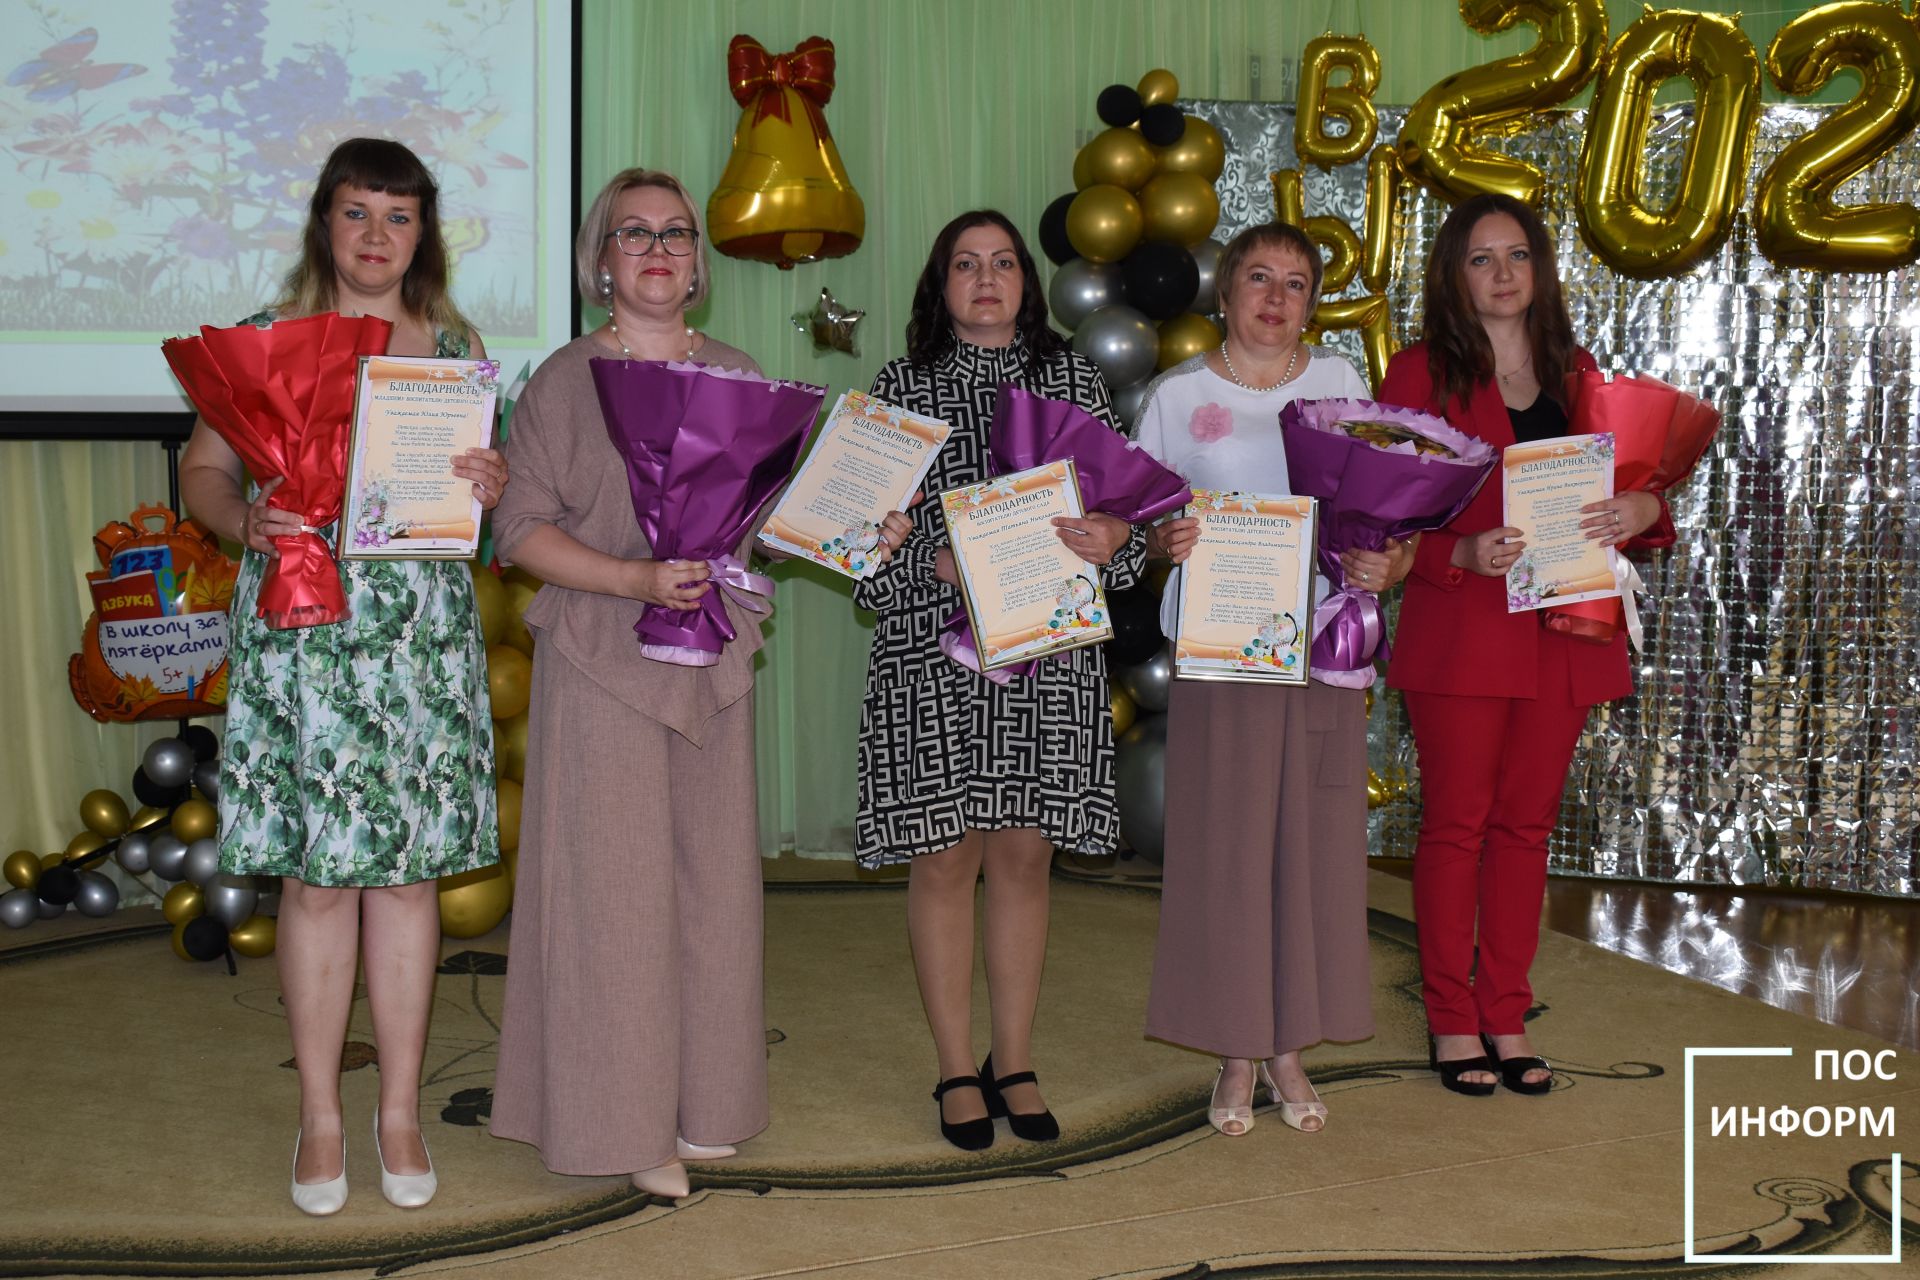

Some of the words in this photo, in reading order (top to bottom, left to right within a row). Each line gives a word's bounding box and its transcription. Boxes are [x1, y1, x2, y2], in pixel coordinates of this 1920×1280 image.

[389, 382, 478, 396] БЛАГОДАРНОСТЬ
[852, 416, 923, 450] БЛАГОДАРНОСТЬ
[901, 447, 913, 455] САДА
[1521, 455, 1598, 473] БЛАГОДАРНОСТЬ
[968, 488, 1054, 520] БЛАГОДАРНОСТЬ
[1036, 501, 1050, 510] САДА
[1206, 514, 1291, 528] БЛАГОДАРНОСТЬ
[116, 550, 164, 574] 123
[102, 594, 154, 611] АЗБУКА
[121, 622, 189, 639] школу
[197, 618, 219, 631] за
[108, 636, 223, 663] пятёрками
[163, 667, 183, 684] 5+
